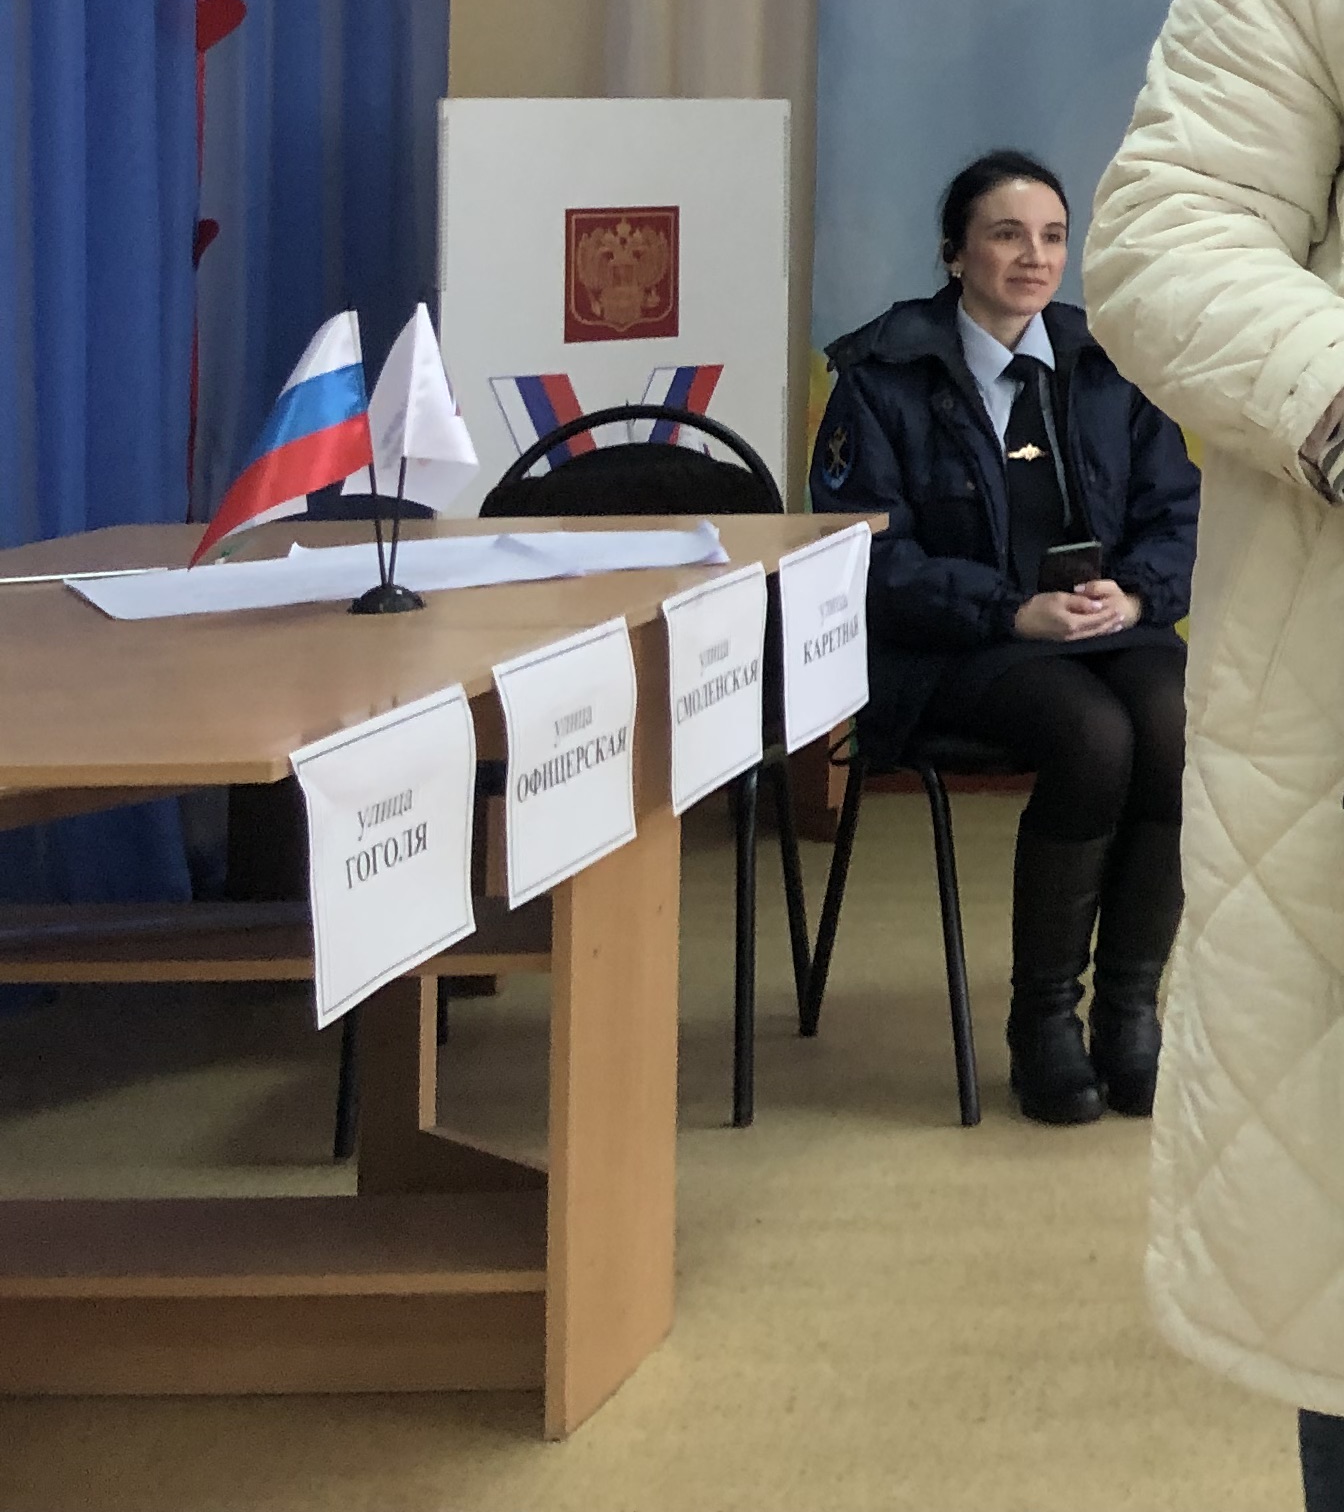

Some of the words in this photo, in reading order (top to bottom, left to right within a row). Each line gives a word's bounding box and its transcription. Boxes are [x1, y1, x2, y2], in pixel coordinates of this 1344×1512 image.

[803, 614, 859, 665] КАРЕТНАЯ
[676, 659, 760, 725] СМОЛЕНСКАЯ
[554, 700, 593, 748] улица
[516, 725, 628, 803] ОФИЦЕРСКАЯ
[357, 788, 413, 841] улица
[345, 821, 429, 890] ГОГОЛЯ
